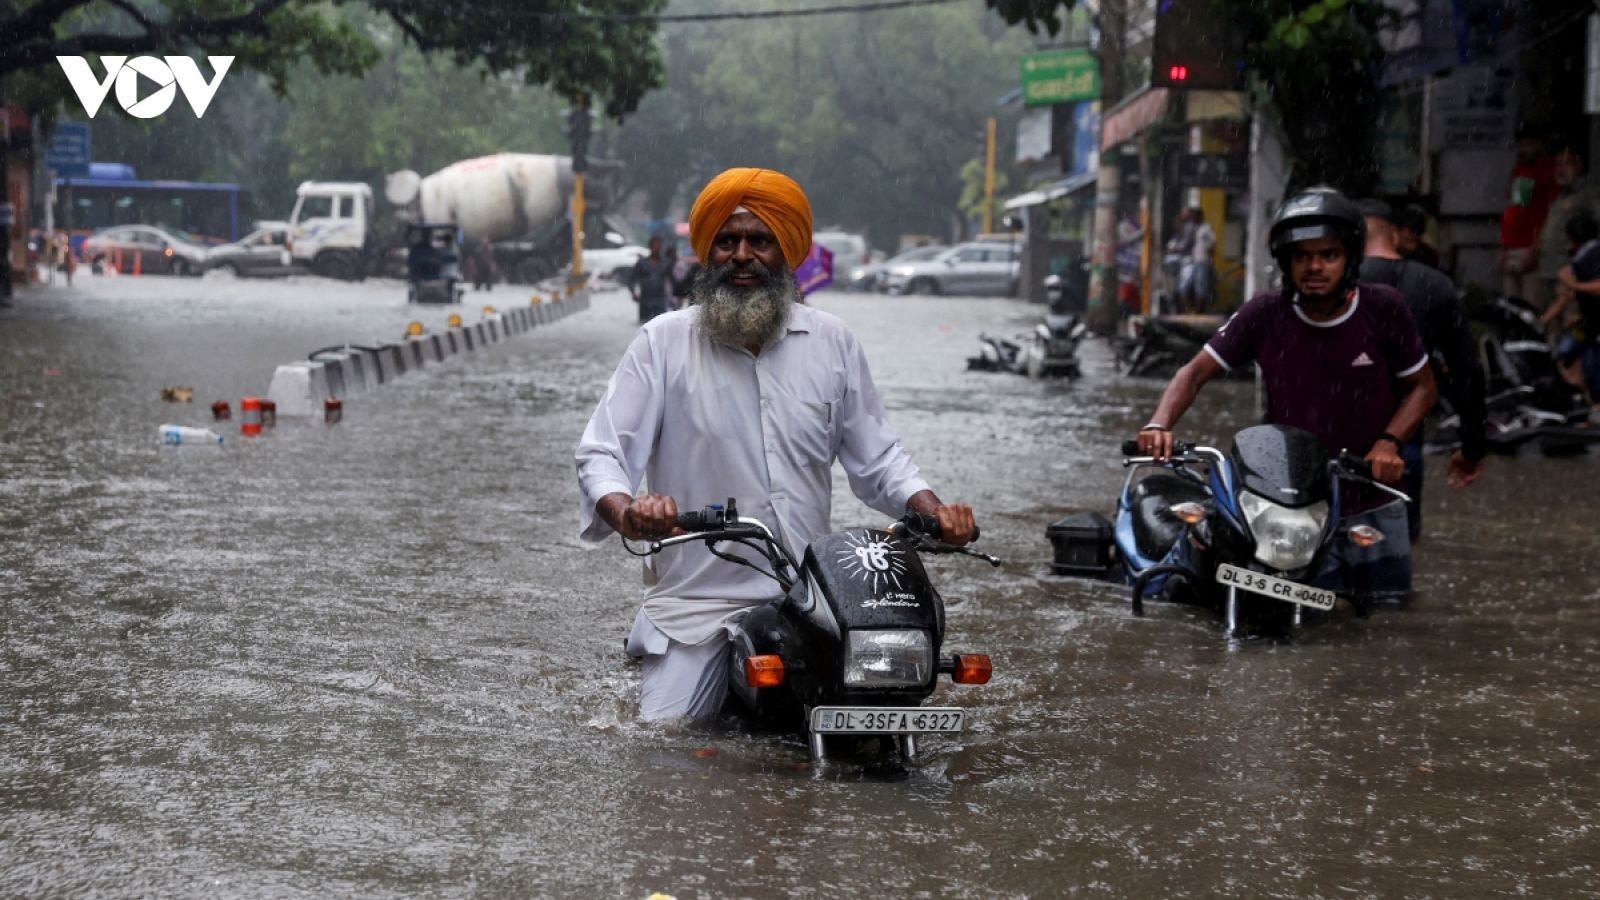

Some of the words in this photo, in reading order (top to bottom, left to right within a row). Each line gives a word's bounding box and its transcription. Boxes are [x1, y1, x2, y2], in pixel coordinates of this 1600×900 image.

[1223, 569, 1240, 584] DL
[1272, 582, 1292, 597] CR
[834, 712, 855, 729] DL
[865, 713, 908, 730] 3SFA
[918, 713, 961, 730] 6327
